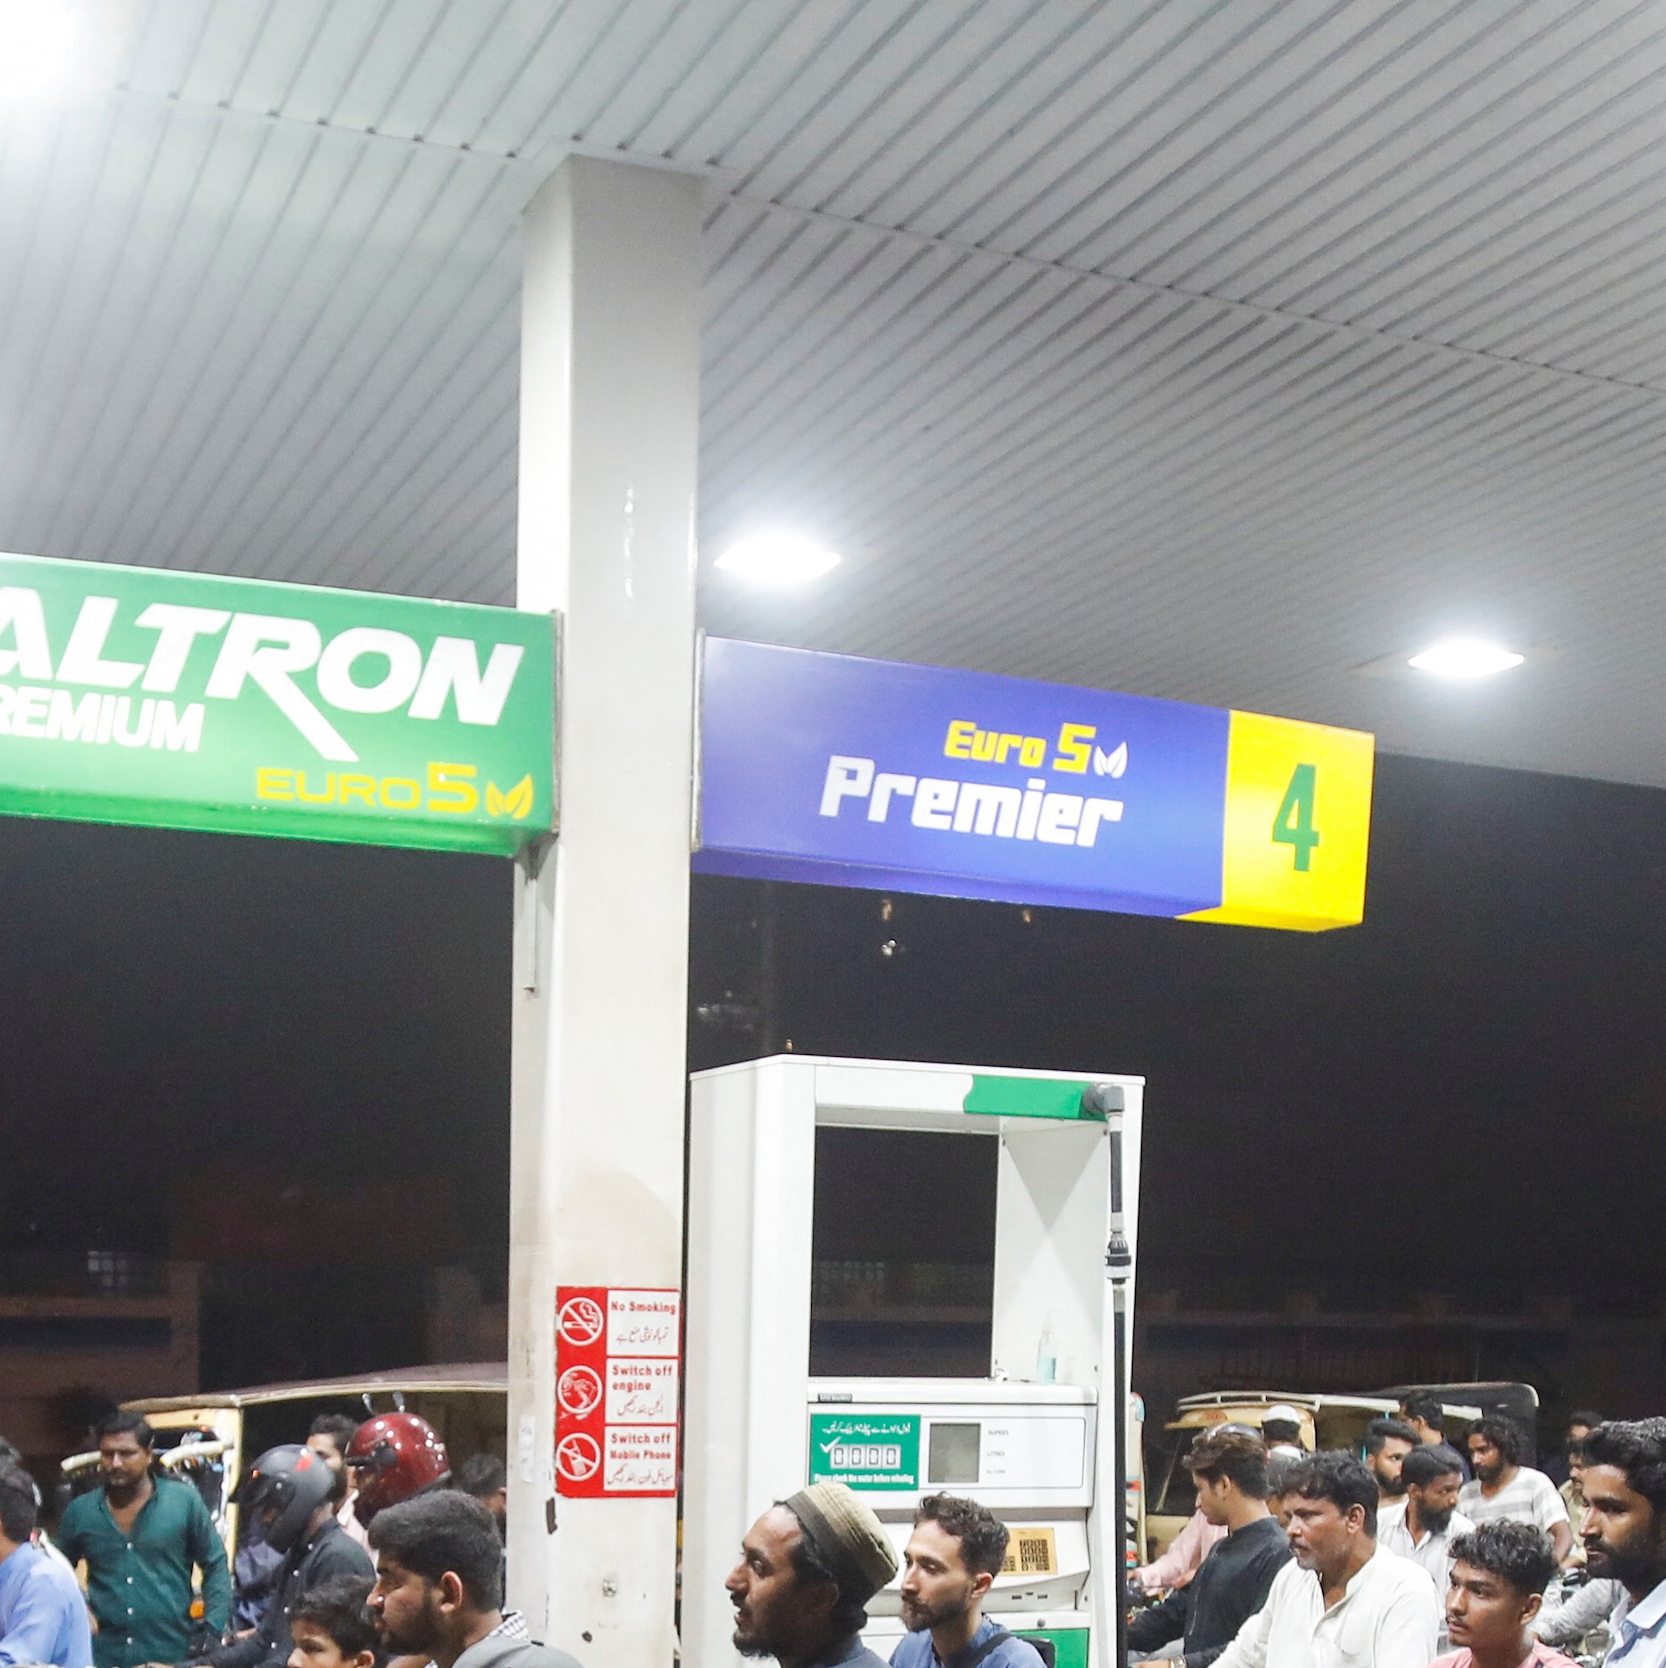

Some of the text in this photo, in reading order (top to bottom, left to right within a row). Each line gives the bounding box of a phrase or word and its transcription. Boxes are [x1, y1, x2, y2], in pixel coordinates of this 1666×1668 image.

[944, 720, 1097, 774] Euro 5
[819, 755, 1124, 847] Premier
[1272, 764, 1320, 872] 4
[611, 1301, 676, 1315] No Smoking
[613, 1365, 672, 1376] Switch off
[612, 1380, 651, 1393] engine
[611, 1433, 670, 1444] Switch off
[610, 1450, 671, 1459] Mobile Phone
